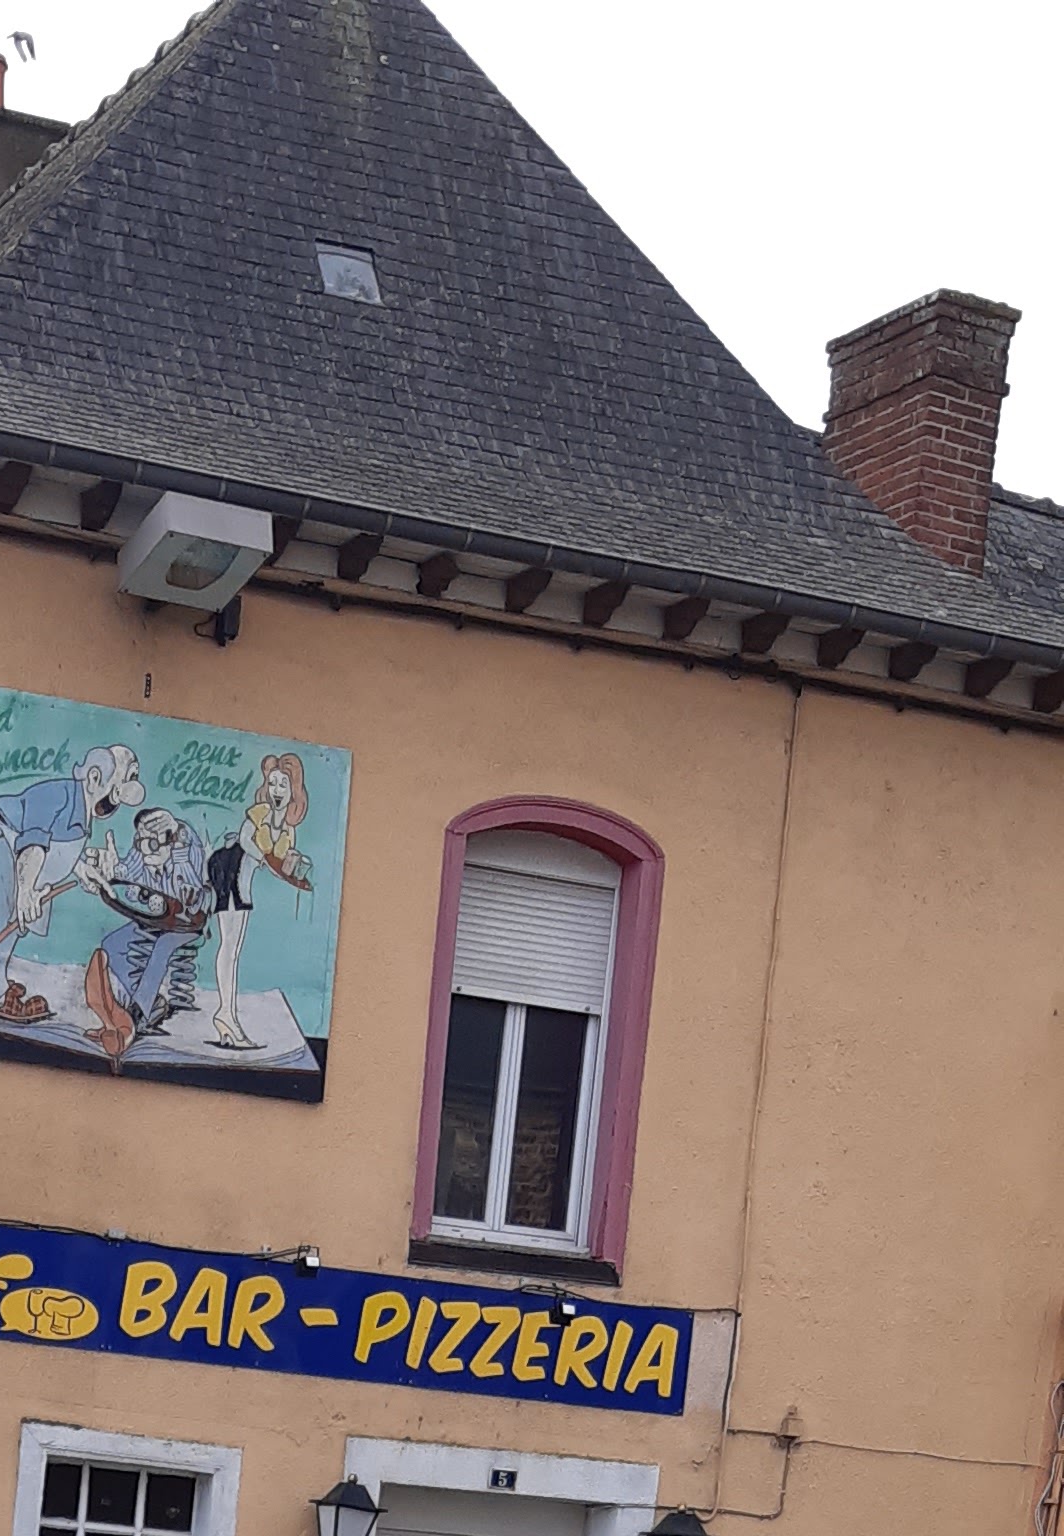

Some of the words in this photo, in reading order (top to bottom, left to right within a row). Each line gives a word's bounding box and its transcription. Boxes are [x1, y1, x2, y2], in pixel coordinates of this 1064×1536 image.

[119, 1260, 286, 1352] BAR
[353, 1290, 679, 1398] PIZZERIA
[497, 1471, 508, 1487] 5
